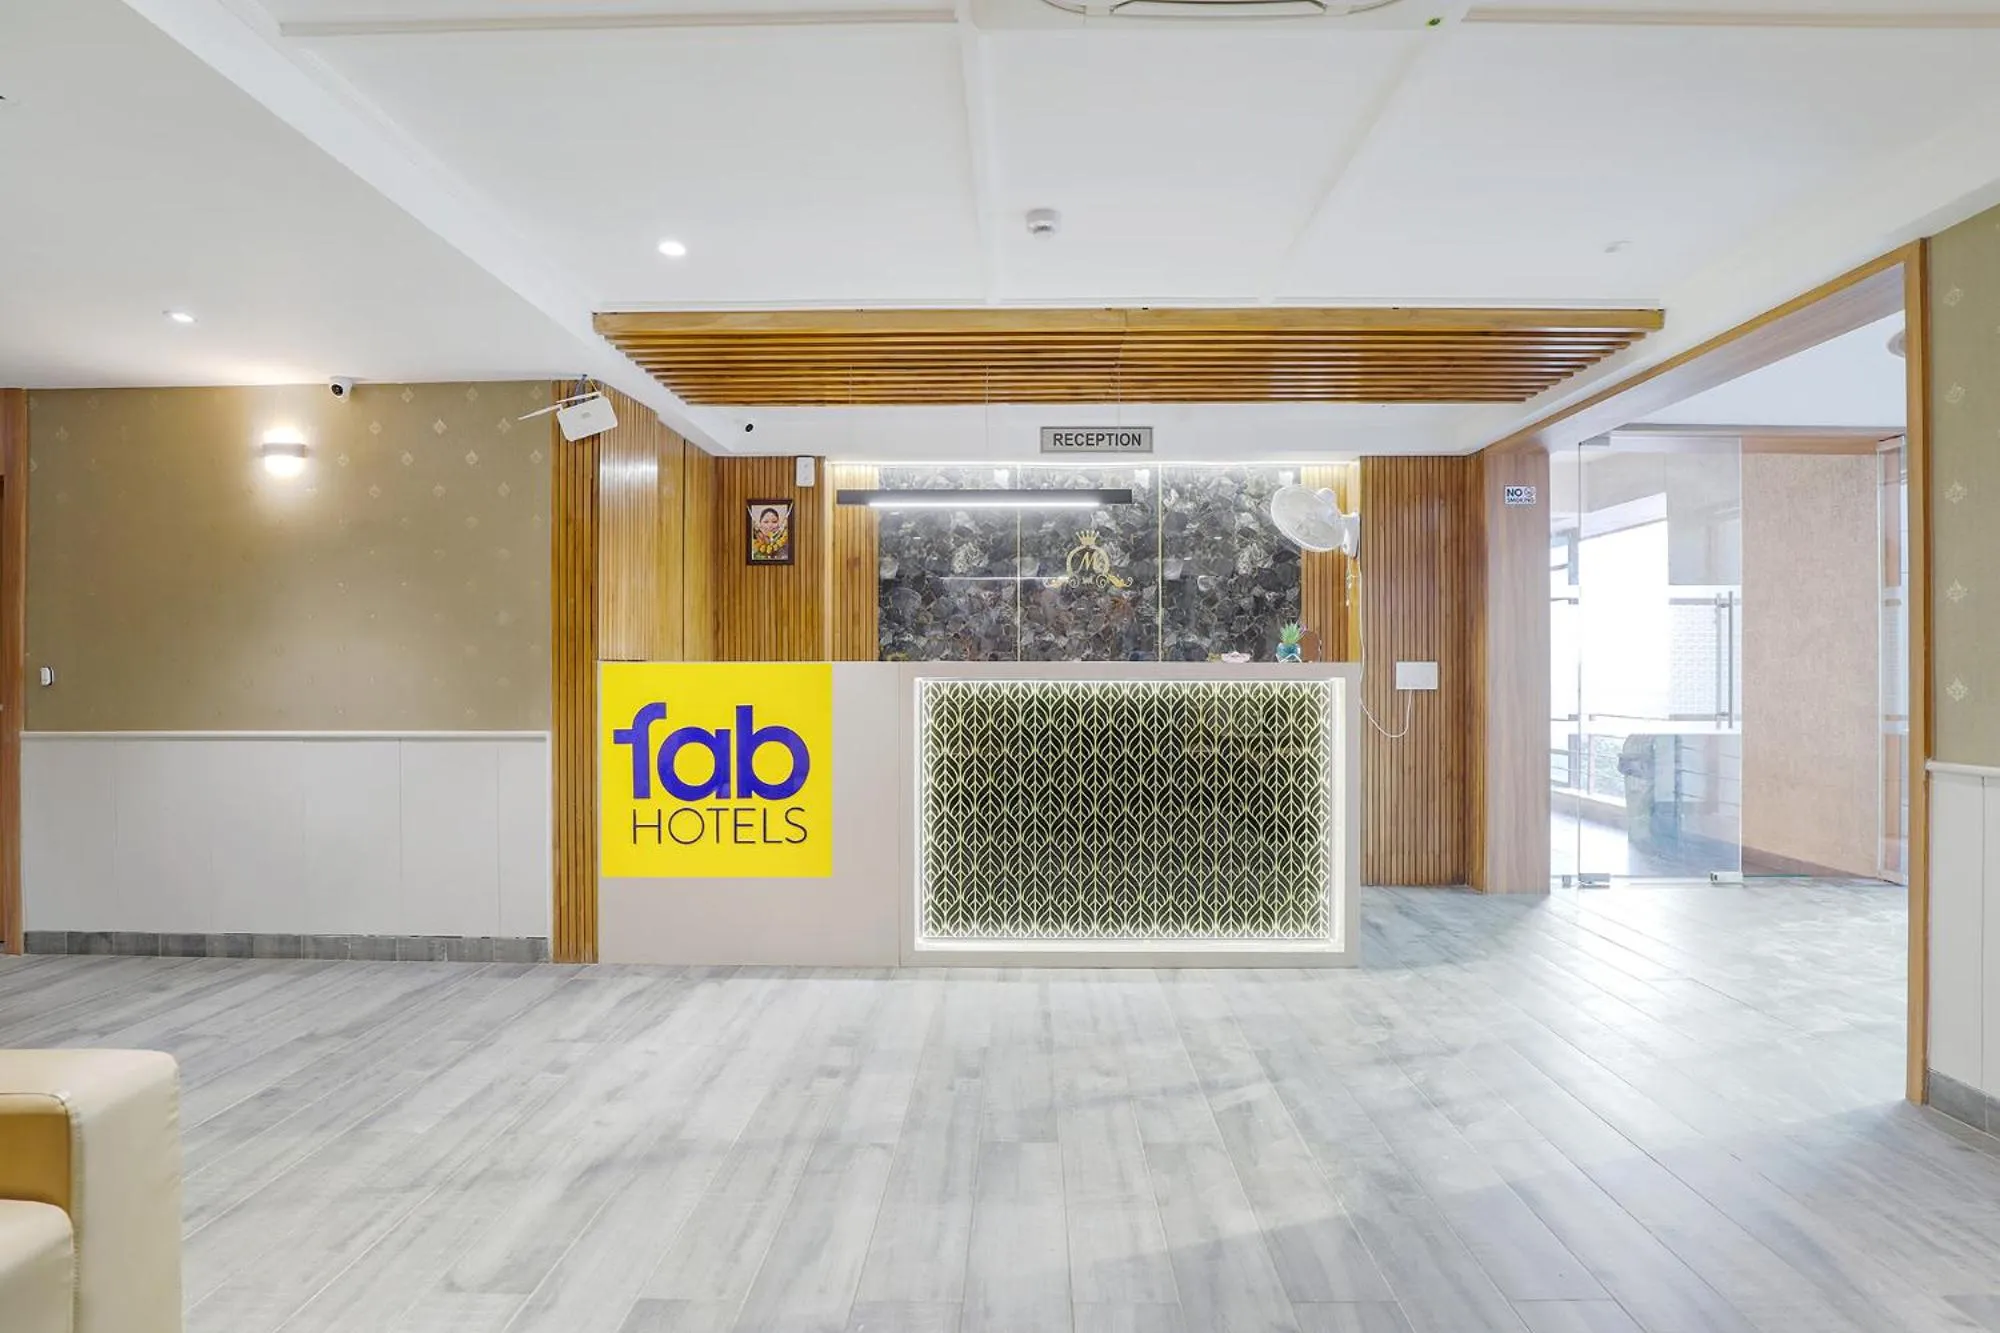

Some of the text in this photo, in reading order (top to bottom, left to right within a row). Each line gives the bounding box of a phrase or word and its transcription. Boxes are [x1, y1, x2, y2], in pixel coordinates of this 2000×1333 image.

[1053, 432, 1142, 446] RECEPTION
[1507, 488, 1523, 497] NO
[612, 702, 810, 801] fab
[632, 807, 808, 845] HOTELS
